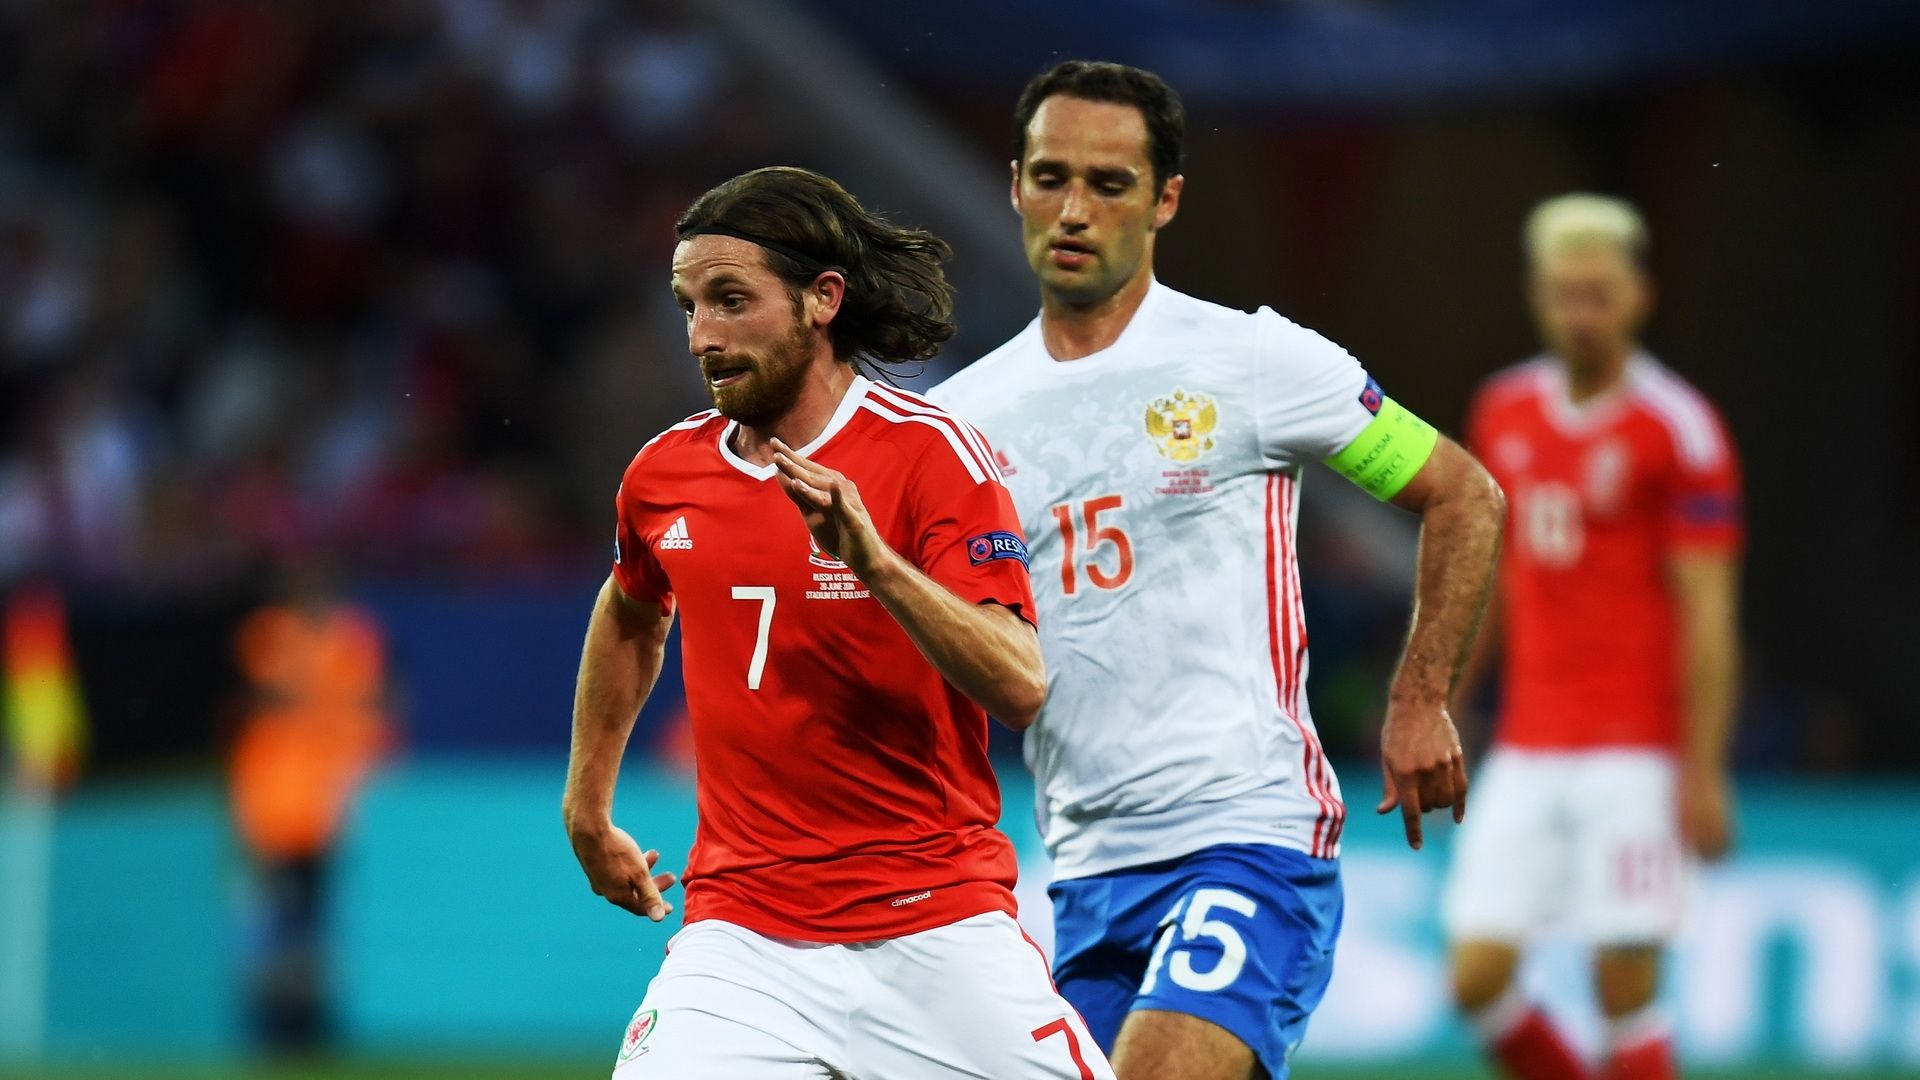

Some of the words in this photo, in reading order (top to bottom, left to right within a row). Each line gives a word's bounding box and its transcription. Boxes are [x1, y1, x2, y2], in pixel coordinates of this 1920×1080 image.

[661, 538, 692, 550] adidas
[1052, 495, 1134, 595] 15
[813, 573, 833, 581] RUSSIA
[834, 573, 842, 581] VS
[842, 573, 859, 581] WALE
[805, 591, 830, 599] STADIUM
[831, 591, 840, 599] DE
[840, 590, 870, 599] TOULOUSE
[827, 582, 842, 590] JUNE
[731, 586, 777, 690] 7
[891, 890, 931, 907] climacool
[1139, 888, 1257, 995] 15
[1031, 1017, 1095, 1080] 7
